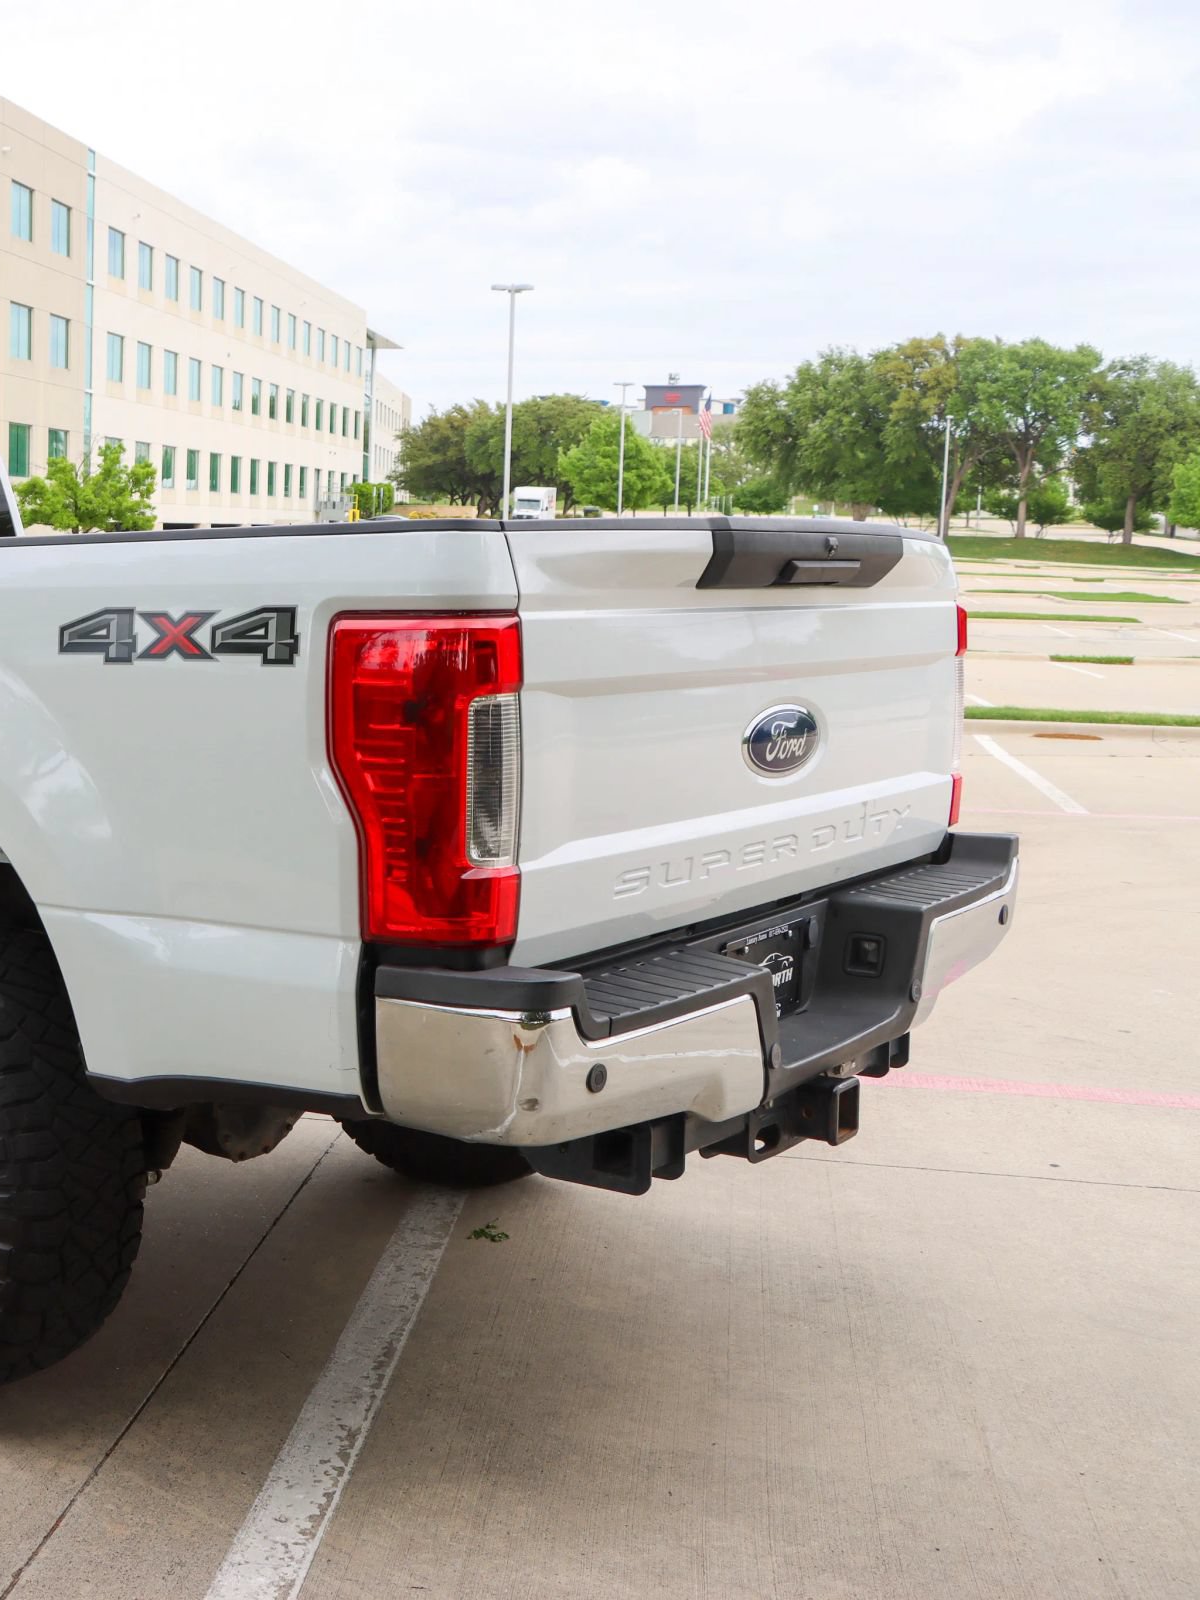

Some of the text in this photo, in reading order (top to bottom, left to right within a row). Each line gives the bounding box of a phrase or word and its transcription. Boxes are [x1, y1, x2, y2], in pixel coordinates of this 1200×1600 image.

[765, 720, 808, 762] Ford
[612, 801, 912, 900] SUPER DUTY
[772, 967, 794, 987] ORTH
